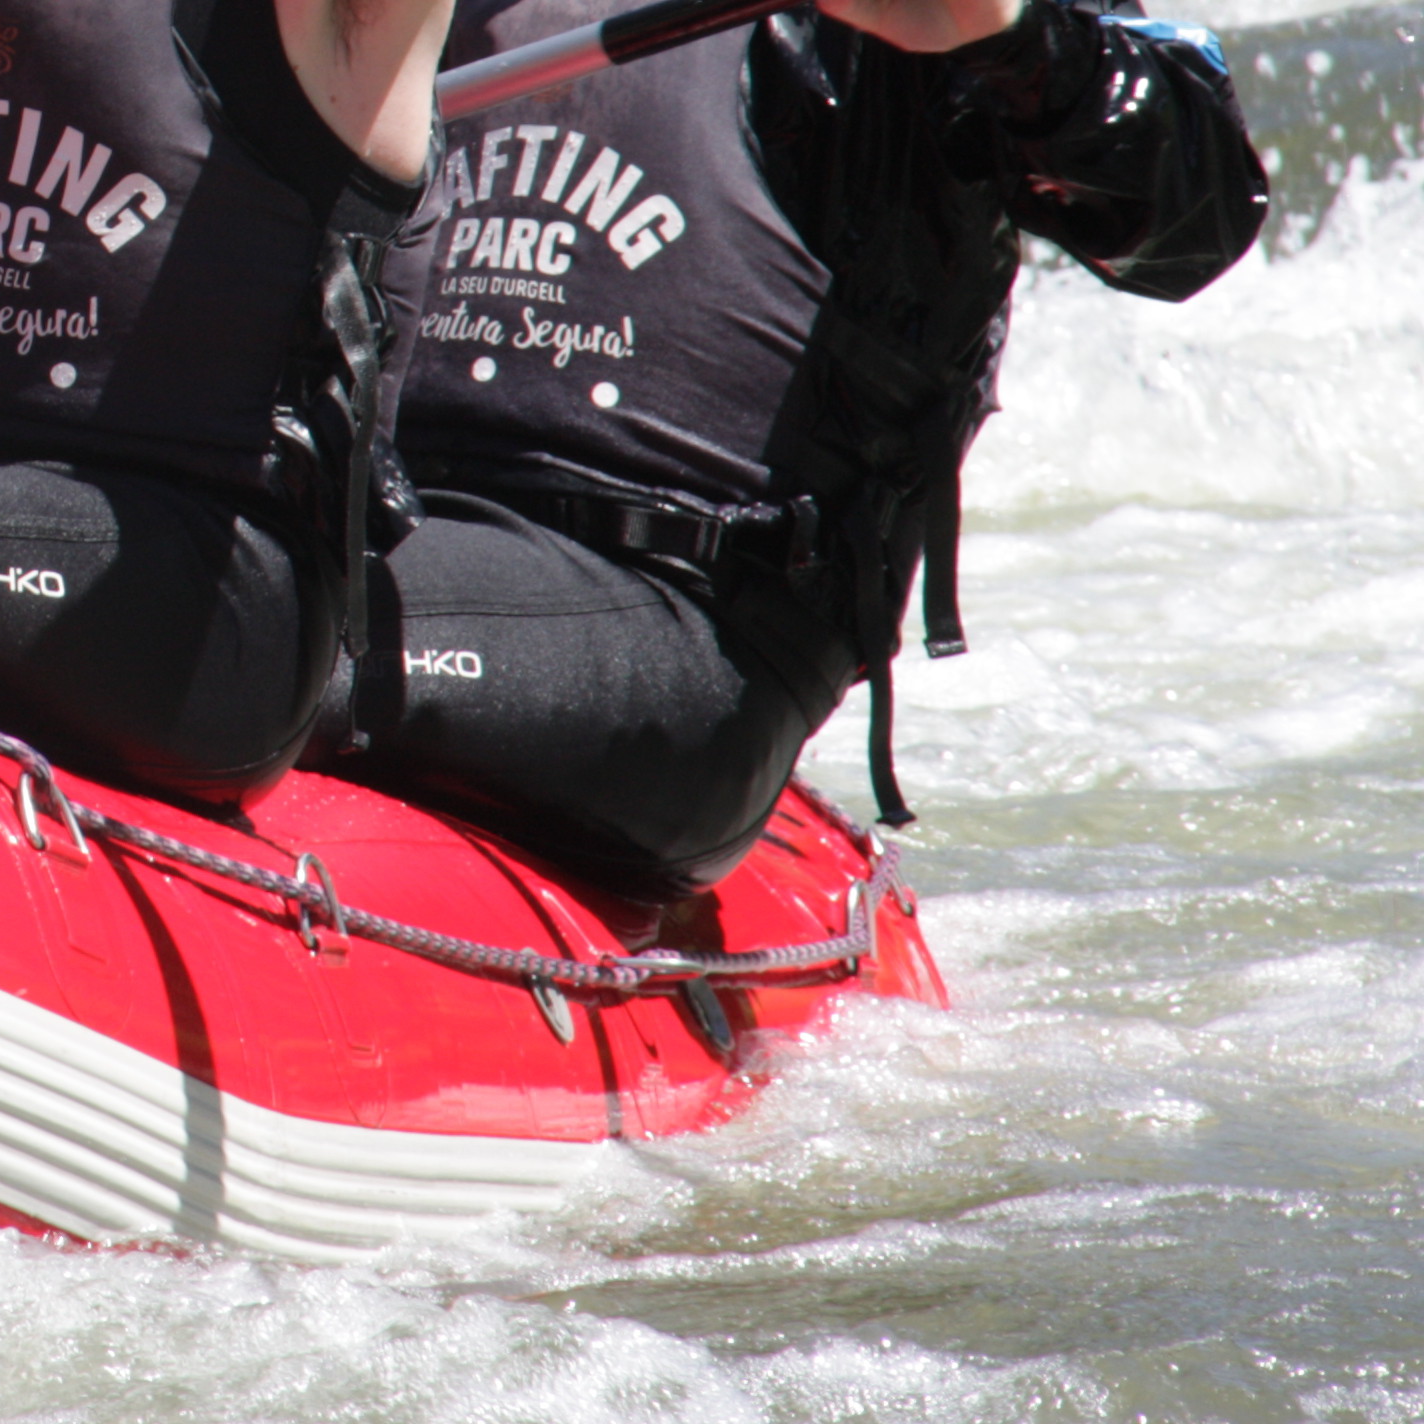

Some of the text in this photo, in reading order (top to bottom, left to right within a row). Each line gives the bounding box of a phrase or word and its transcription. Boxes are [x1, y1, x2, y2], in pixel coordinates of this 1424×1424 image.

[441, 124, 686, 271] AFTING
[446, 217, 577, 276] PARC
[441, 276, 566, 304] LA SEU D'URGELL
[512, 306, 635, 368] Segura!
